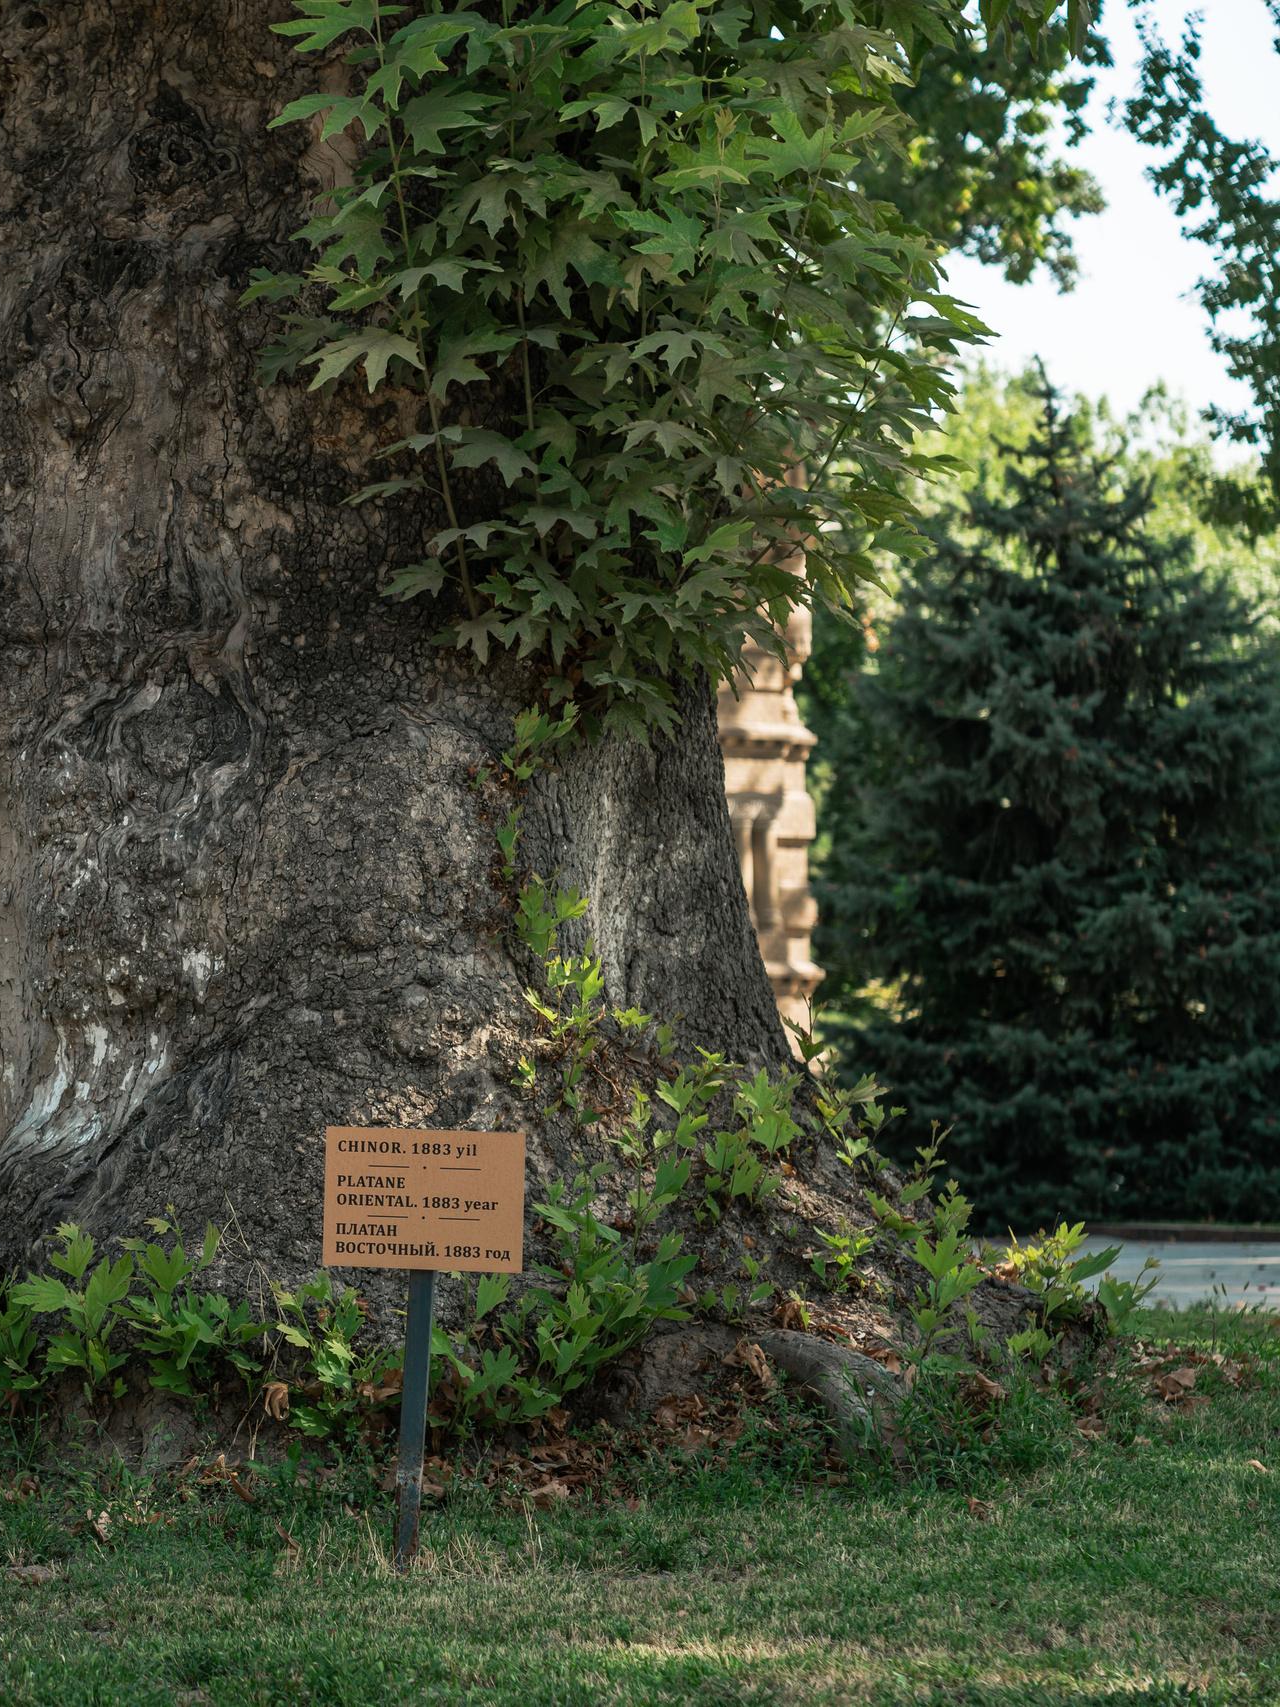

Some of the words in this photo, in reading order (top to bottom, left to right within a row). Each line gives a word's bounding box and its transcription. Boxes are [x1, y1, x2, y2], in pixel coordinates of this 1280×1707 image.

[338, 1140, 406, 1154] CHINOR.
[411, 1142, 451, 1155] 1883
[456, 1144, 477, 1159] yil
[337, 1175, 405, 1189] PLATANE
[336, 1193, 418, 1208] ORIENTAL.
[422, 1196, 460, 1209] 1883
[464, 1199, 498, 1212] year
[336, 1223, 397, 1236] ПЛАТАН
[335, 1241, 439, 1257] ВОСТОЧНЫЙ.
[444, 1245, 480, 1258] 1883
[485, 1249, 510, 1262] год
